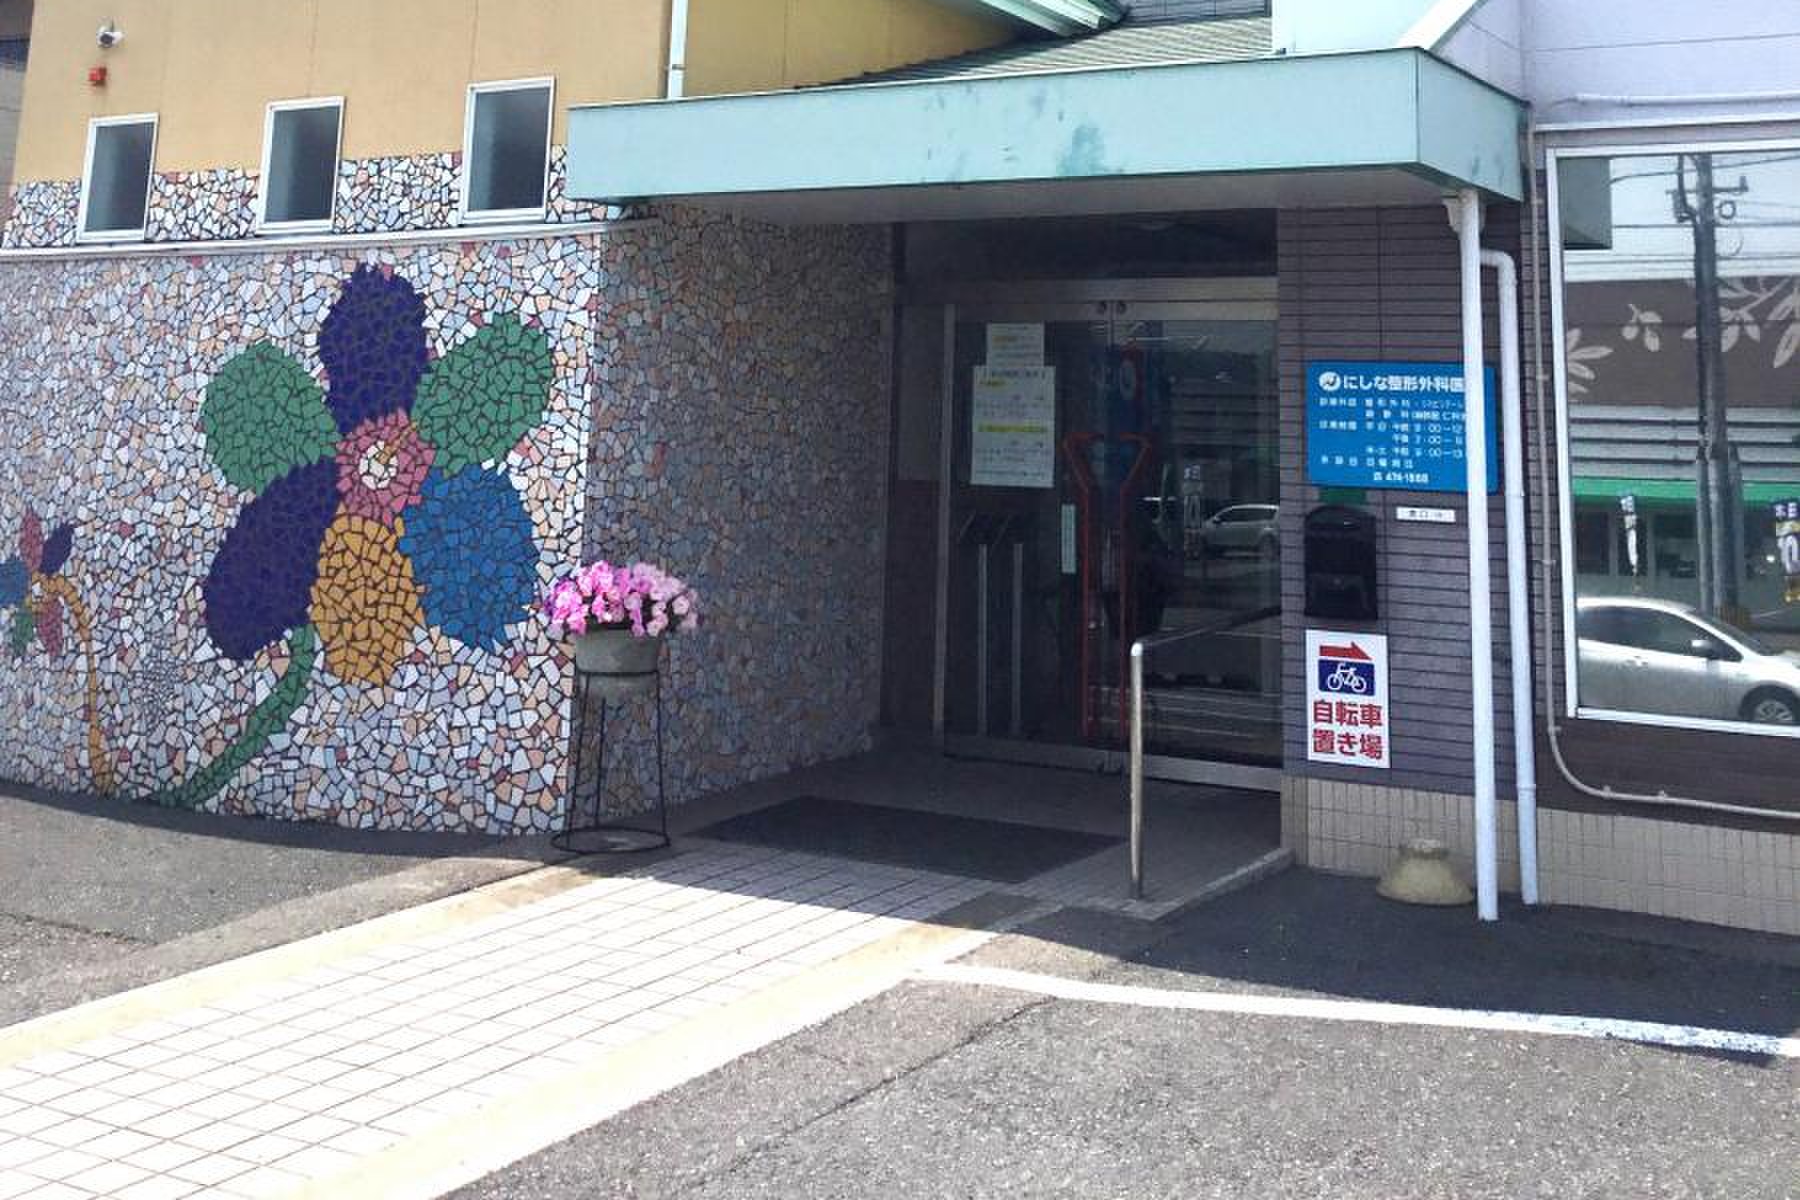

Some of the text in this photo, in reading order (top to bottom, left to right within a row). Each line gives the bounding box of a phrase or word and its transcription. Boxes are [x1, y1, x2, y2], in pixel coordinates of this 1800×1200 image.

[1313, 699, 1383, 729] 自転車
[1312, 729, 1383, 761] 置き場
